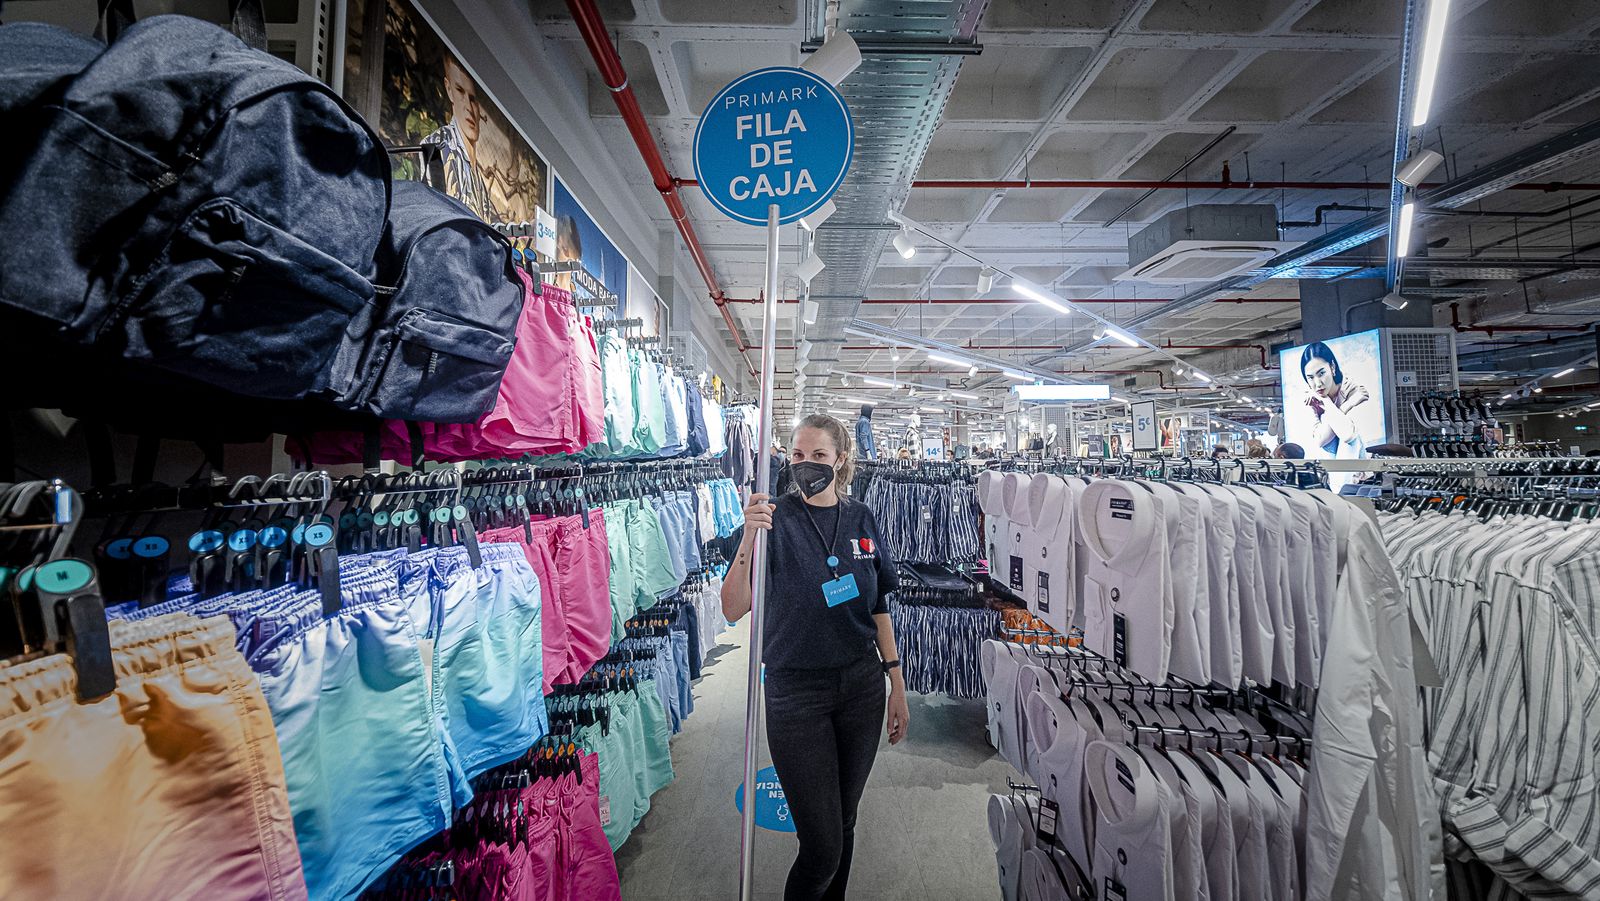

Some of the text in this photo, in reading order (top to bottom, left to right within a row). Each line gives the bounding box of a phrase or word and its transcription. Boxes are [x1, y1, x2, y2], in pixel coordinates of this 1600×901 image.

[725, 85, 818, 110] PRIMARK
[736, 109, 807, 140] FILA
[750, 139, 793, 168] DE
[729, 168, 818, 201] CAJA
[576, 270, 598, 295] MODA
[1138, 417, 1151, 431] 5€
[925, 447, 941, 456] 14€
[56, 571, 69, 581] M
